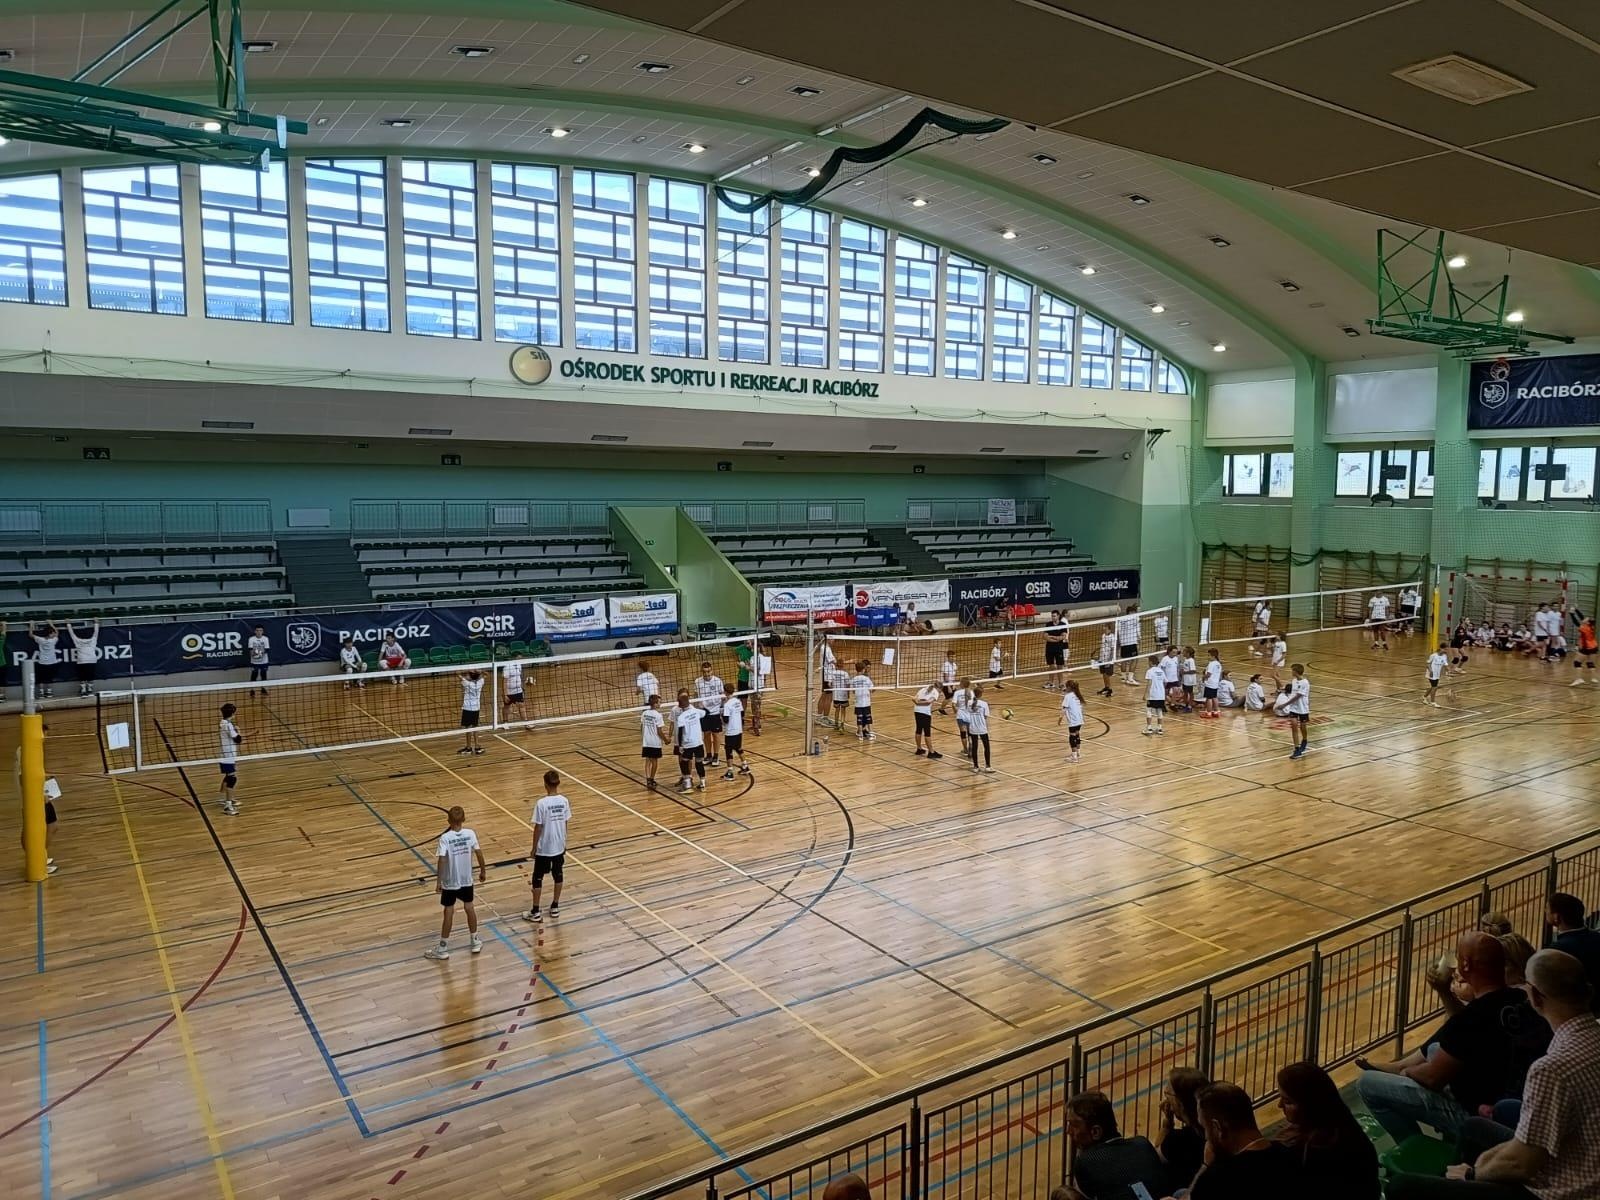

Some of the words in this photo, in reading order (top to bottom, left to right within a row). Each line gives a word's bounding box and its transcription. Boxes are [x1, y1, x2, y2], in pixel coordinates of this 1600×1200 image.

[560, 357, 645, 382] OŚRODEK
[651, 366, 716, 387] SPORTU
[721, 372, 725, 388] I
[731, 373, 808, 393] REKREACJI
[813, 379, 879, 398] RACIBÓRZ
[1025, 581, 1051, 594] OSiR
[1089, 578, 1129, 591] RACIBÓRZ
[960, 585, 1007, 600] RACIBÓRZ
[467, 615, 515, 633] OSiR
[181, 631, 243, 652] OSiR
[206, 650, 244, 658] RACIBÓRZ
